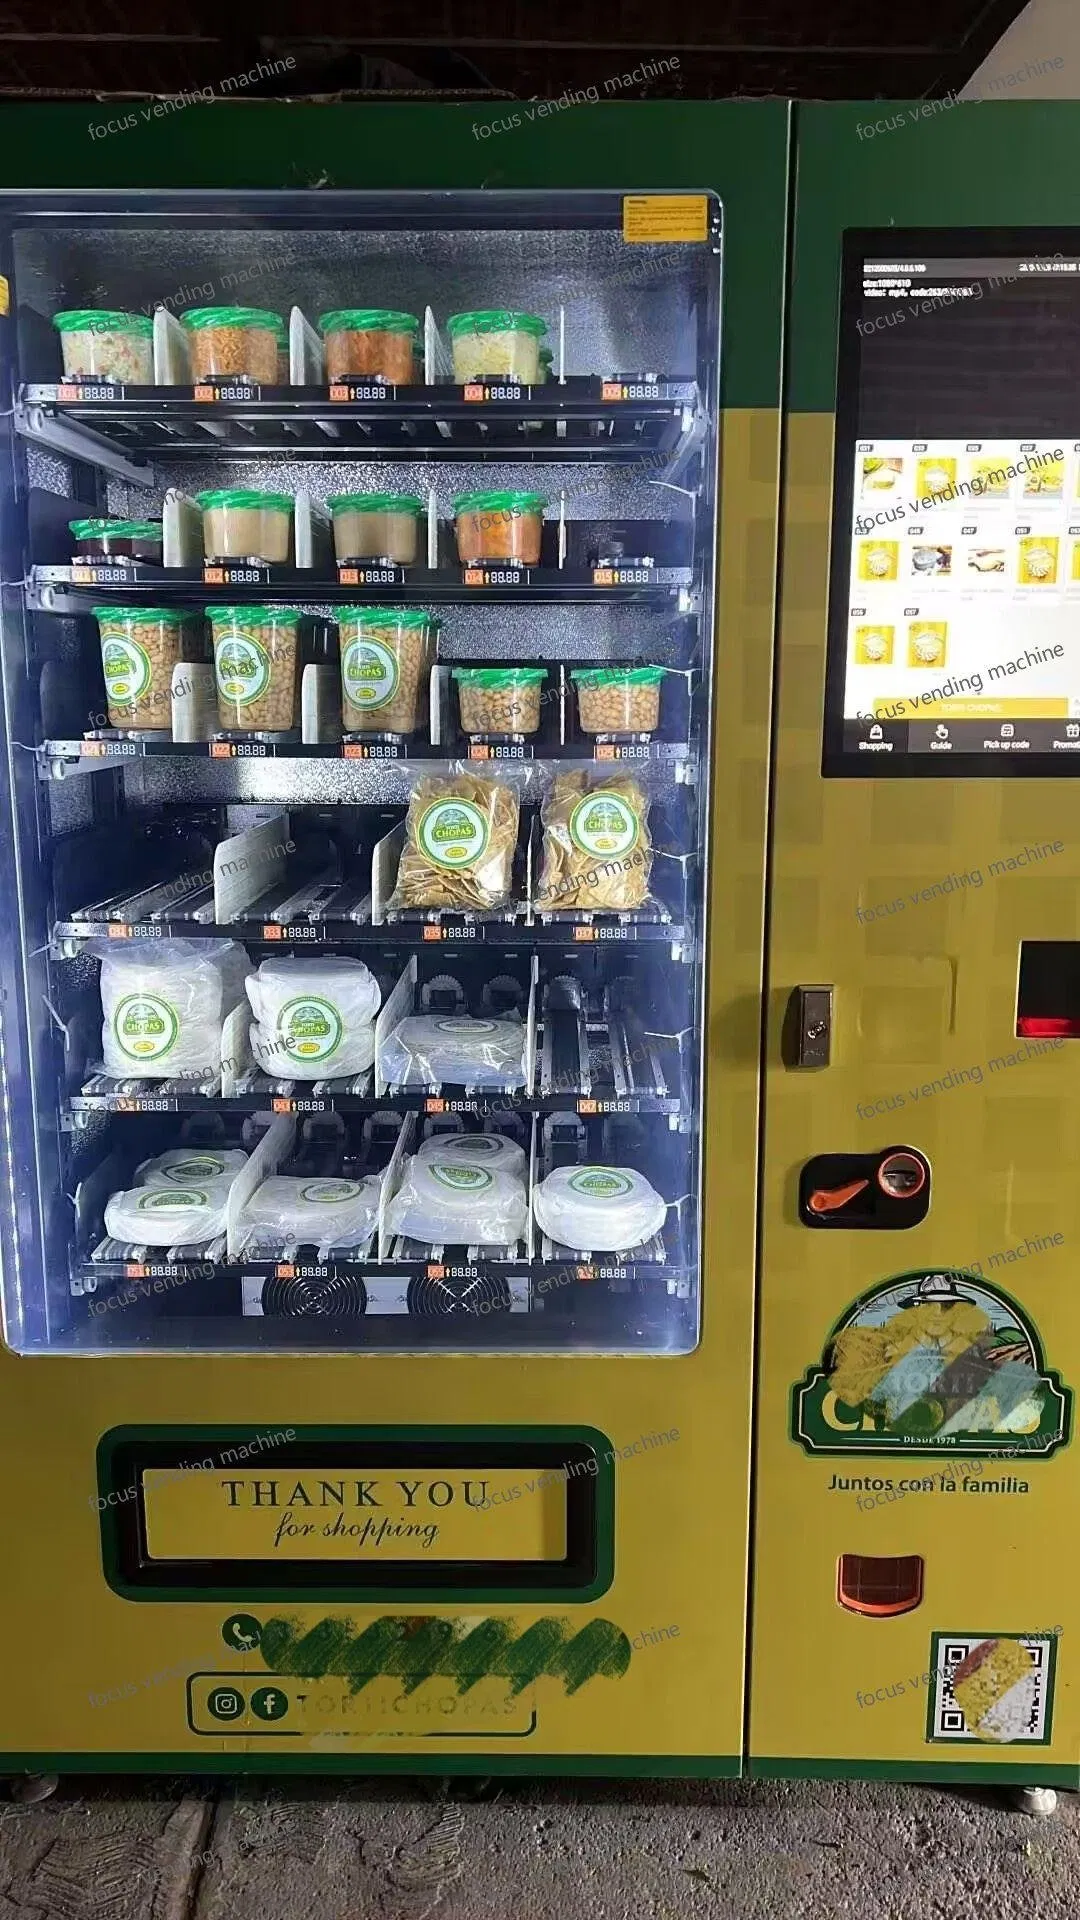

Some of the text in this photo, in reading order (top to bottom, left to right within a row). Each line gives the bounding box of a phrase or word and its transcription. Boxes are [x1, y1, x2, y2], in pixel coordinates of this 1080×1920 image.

[85, 388, 114, 399] 88.88
[221, 388, 250, 399] 88.88
[356, 388, 386, 399] 88.88
[491, 388, 520, 399] 88.88
[629, 386, 658, 398] 88.88
[98, 570, 127, 580] 88.88
[231, 570, 259, 581] 88.88
[366, 571, 394, 582] 88.88
[491, 572, 519, 583] 88.88
[620, 571, 648, 582] 88.88
[350, 668, 382, 677] CHOPAS
[859, 742, 893, 751] Shopping
[930, 742, 953, 750] Guide
[984, 740, 1000, 748] Pick
[107, 744, 135, 755] 88.88
[238, 745, 266, 755] 88.88
[370, 747, 397, 757] 88.88
[496, 747, 523, 758] 88.88
[622, 747, 649, 758] 88.88
[436, 828, 472, 838] CHOPAS
[134, 927, 161, 937] 88.88
[289, 928, 316, 937] 88.88
[449, 928, 475, 938] 88.88
[600, 928, 627, 939] 88.88
[126, 1020, 160, 1030] CHOPAS
[142, 1100, 168, 1110] 88.88
[298, 1101, 324, 1110] 88.88
[604, 1102, 630, 1112] 88.88
[151, 1267, 177, 1276] 88.88
[302, 1267, 327, 1276] 88.88
[451, 1268, 477, 1277] 88.88
[600, 1268, 626, 1278] 88.88
[935, 1436, 956, 1444] 1978
[828, 1474, 1029, 1492] Juntos con la familia
[221, 1481, 490, 1507] THANK YOU
[273, 1512, 440, 1549] for shopping
